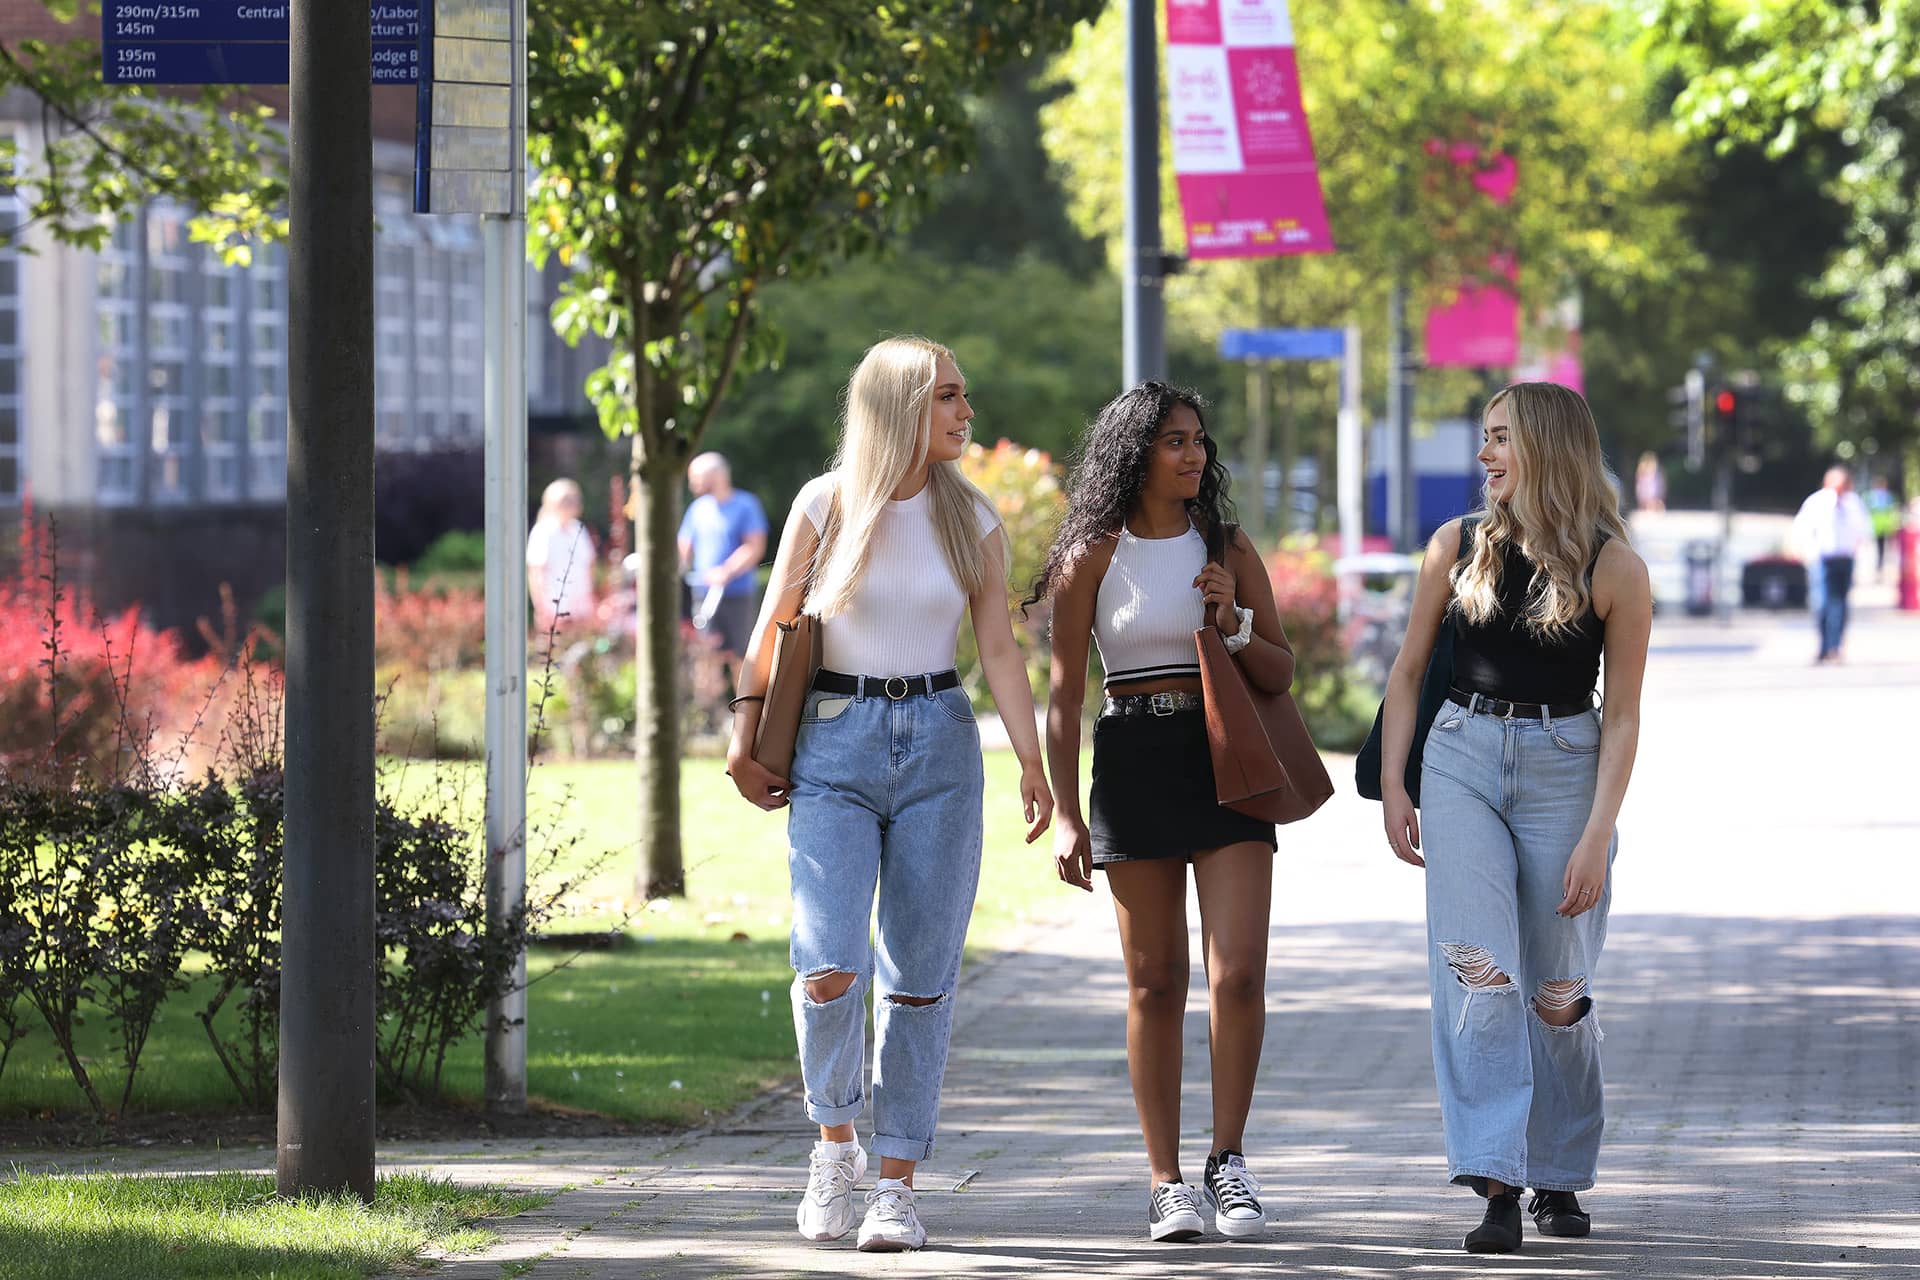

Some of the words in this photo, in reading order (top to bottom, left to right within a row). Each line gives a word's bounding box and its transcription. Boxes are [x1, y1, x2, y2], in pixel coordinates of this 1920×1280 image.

[116, 5, 200, 20] 290m/315m
[237, 5, 285, 19] Central
[116, 22, 155, 35] 145m
[117, 49, 156, 62] 195m
[371, 48, 407, 66] odge
[117, 65, 156, 79] 210m
